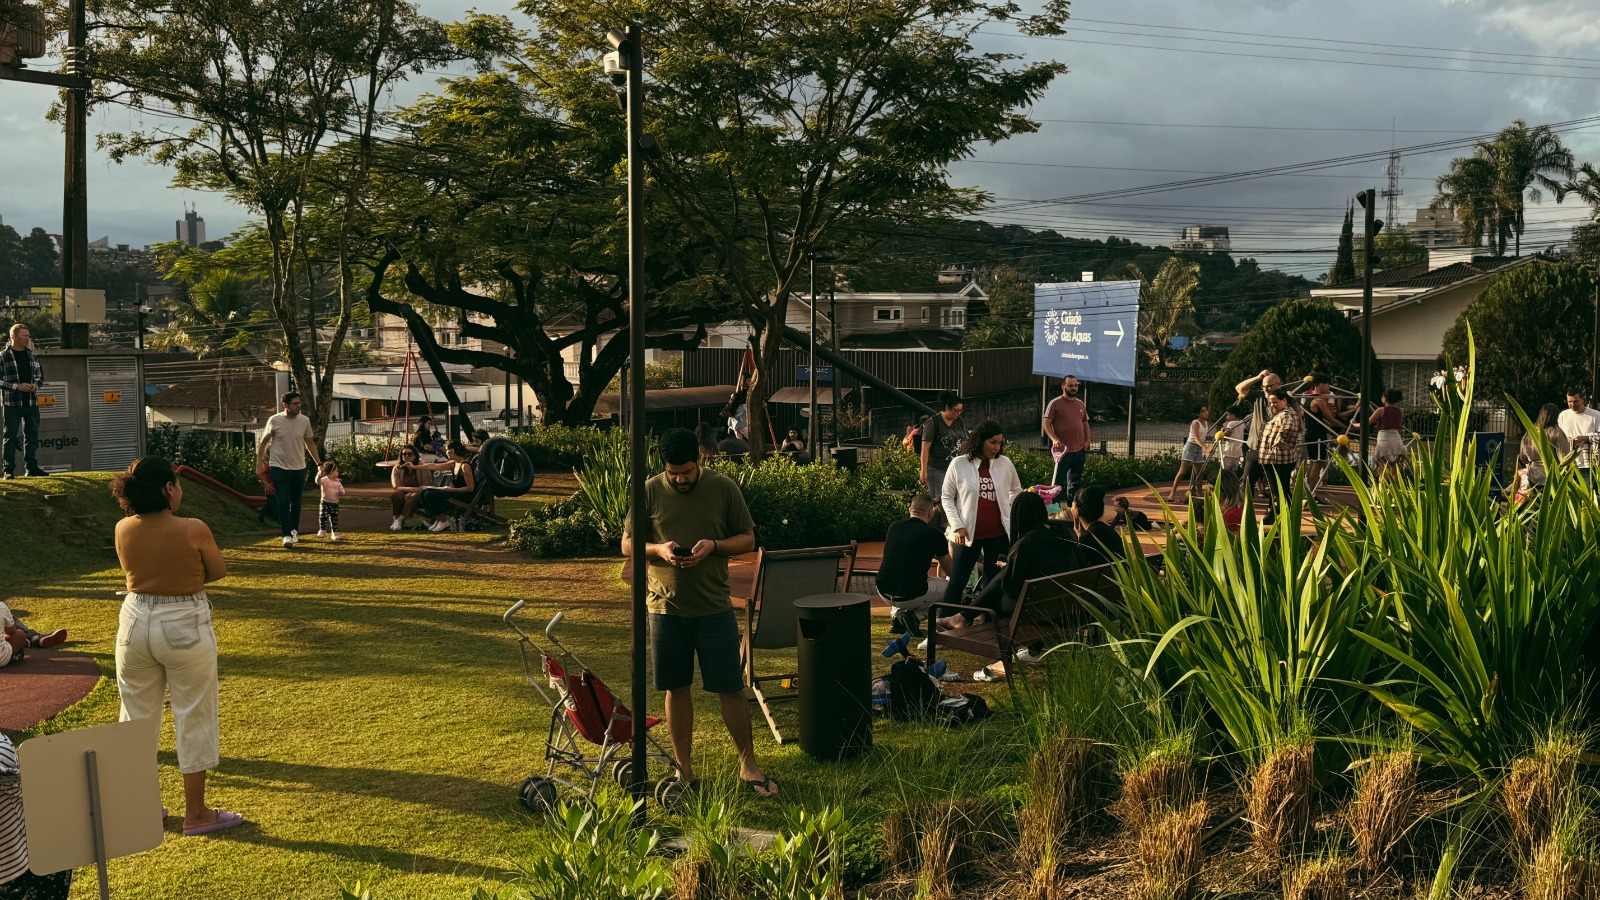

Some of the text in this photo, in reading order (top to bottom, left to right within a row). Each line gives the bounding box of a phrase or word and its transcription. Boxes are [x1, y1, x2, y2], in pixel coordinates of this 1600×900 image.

[1061, 311, 1082, 325] Cidade
[1061, 327, 1091, 345] das Águas
[37, 435, 79, 450] nergise
